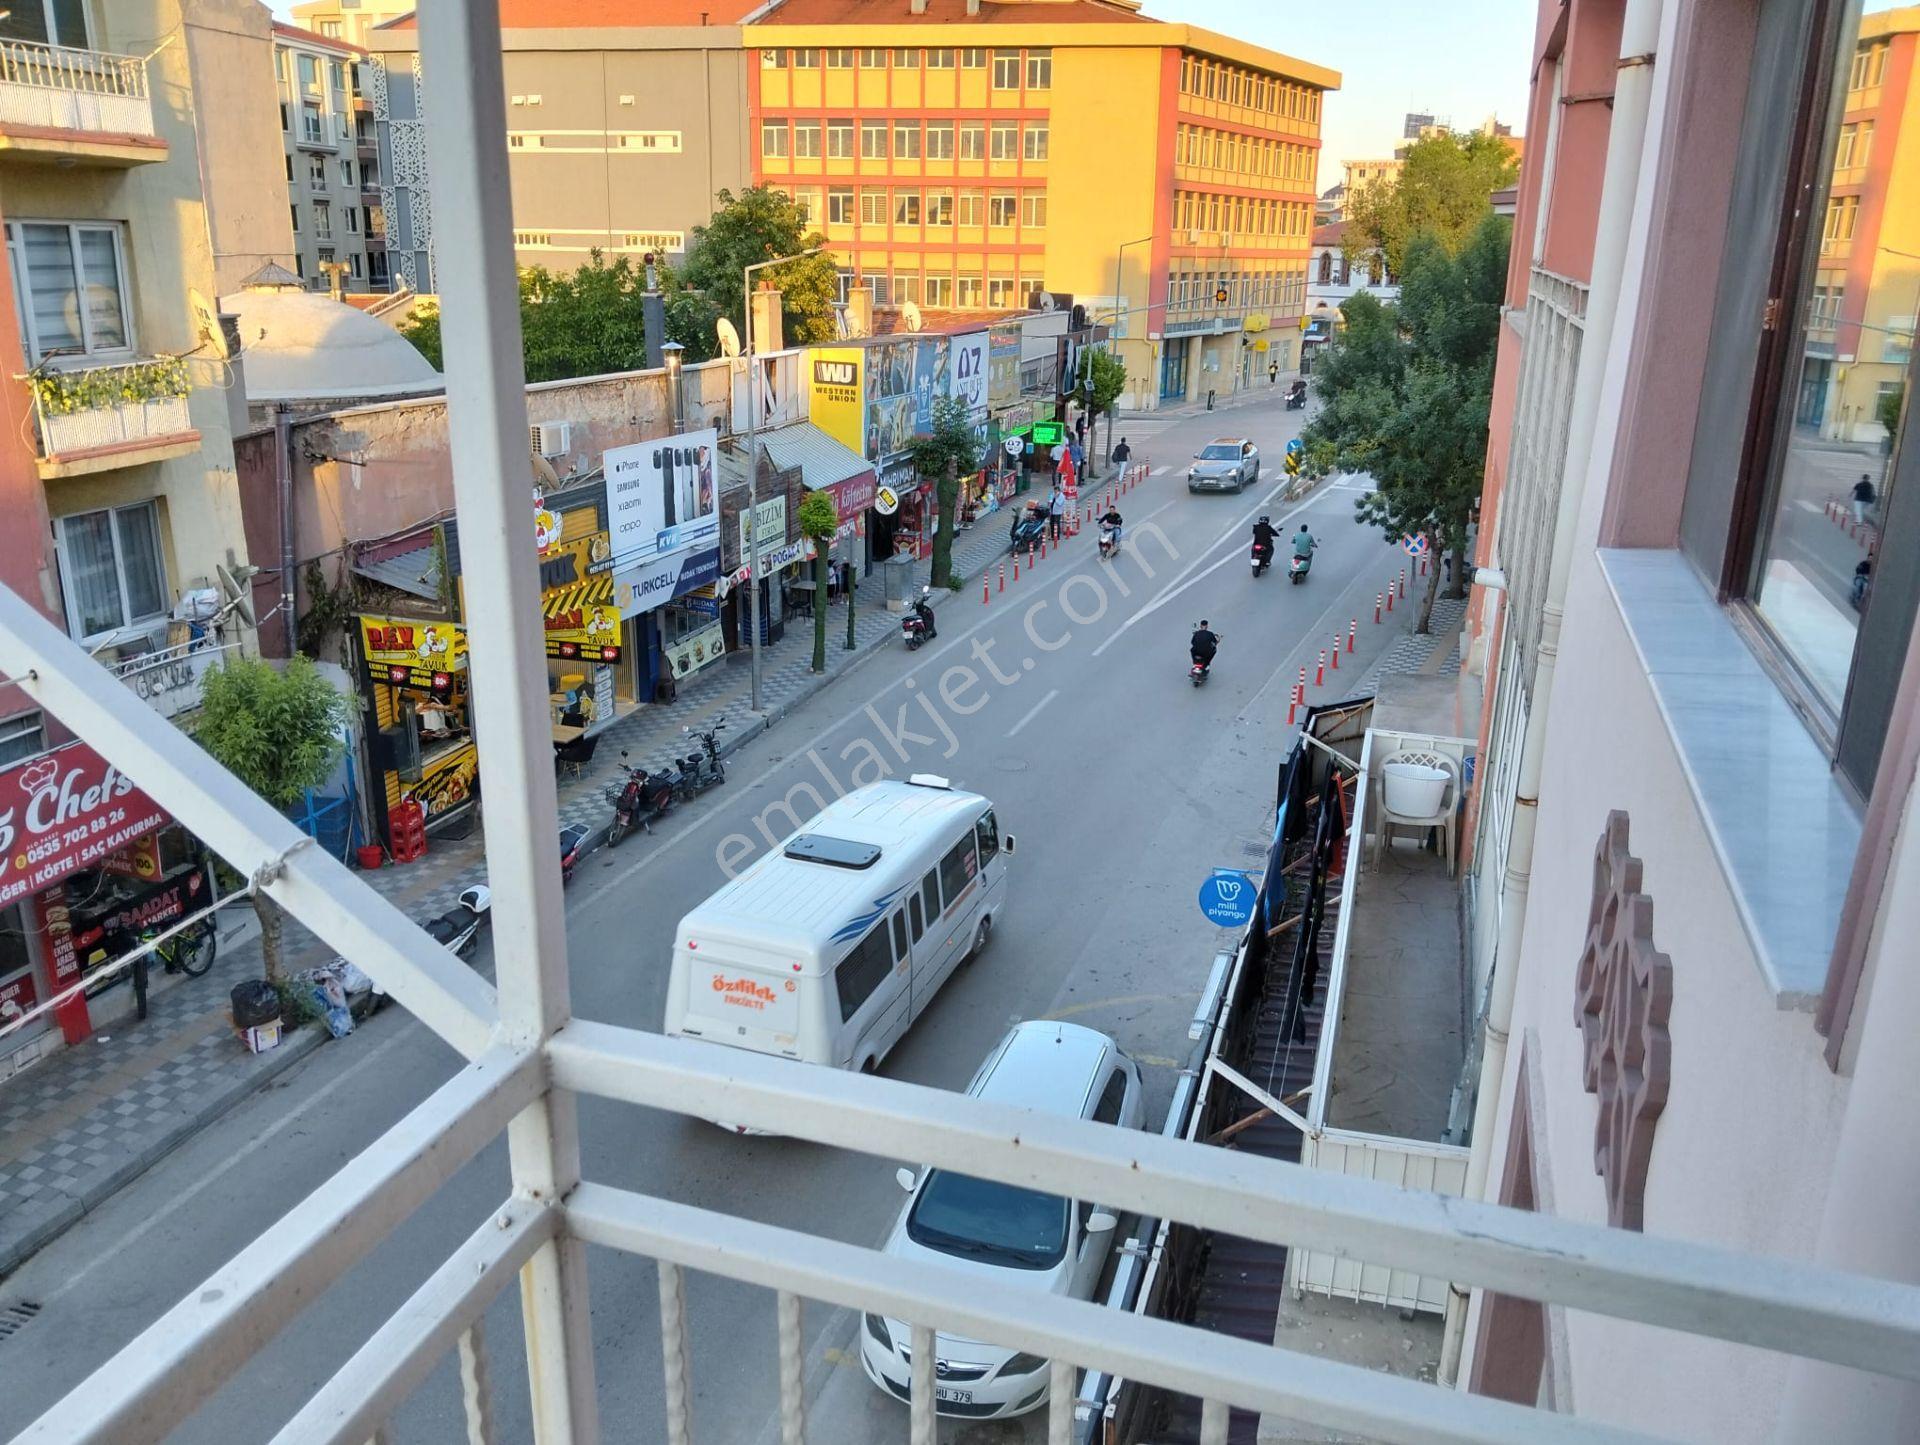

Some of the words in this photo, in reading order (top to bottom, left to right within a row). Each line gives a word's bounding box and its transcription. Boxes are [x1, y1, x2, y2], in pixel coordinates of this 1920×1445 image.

[816, 362, 853, 383] WU
[815, 386, 856, 396] WESTERN
[828, 394, 856, 403] UNION
[621, 460, 640, 472] iPhone
[616, 478, 640, 493] SAMSUNG
[617, 498, 642, 511] xiaomi
[619, 519, 641, 533] oppo
[632, 571, 675, 599] TURKCELL
[27, 838, 61, 864] 0535
[63, 825, 89, 847] 702
[90, 815, 107, 834] 88
[109, 807, 126, 826] 26
[0, 878, 27, 901] ĞER
[36, 856, 75, 885] KÖFTE
[81, 840, 107, 862] SAÇ
[107, 813, 163, 849] KAVURMA
[1208, 907, 1246, 919] piyango
[1217, 901, 1238, 911] milli
[712, 973, 776, 1003] Özdilek
[936, 1388, 948, 1399] HU
[952, 1391, 971, 1403] 379
